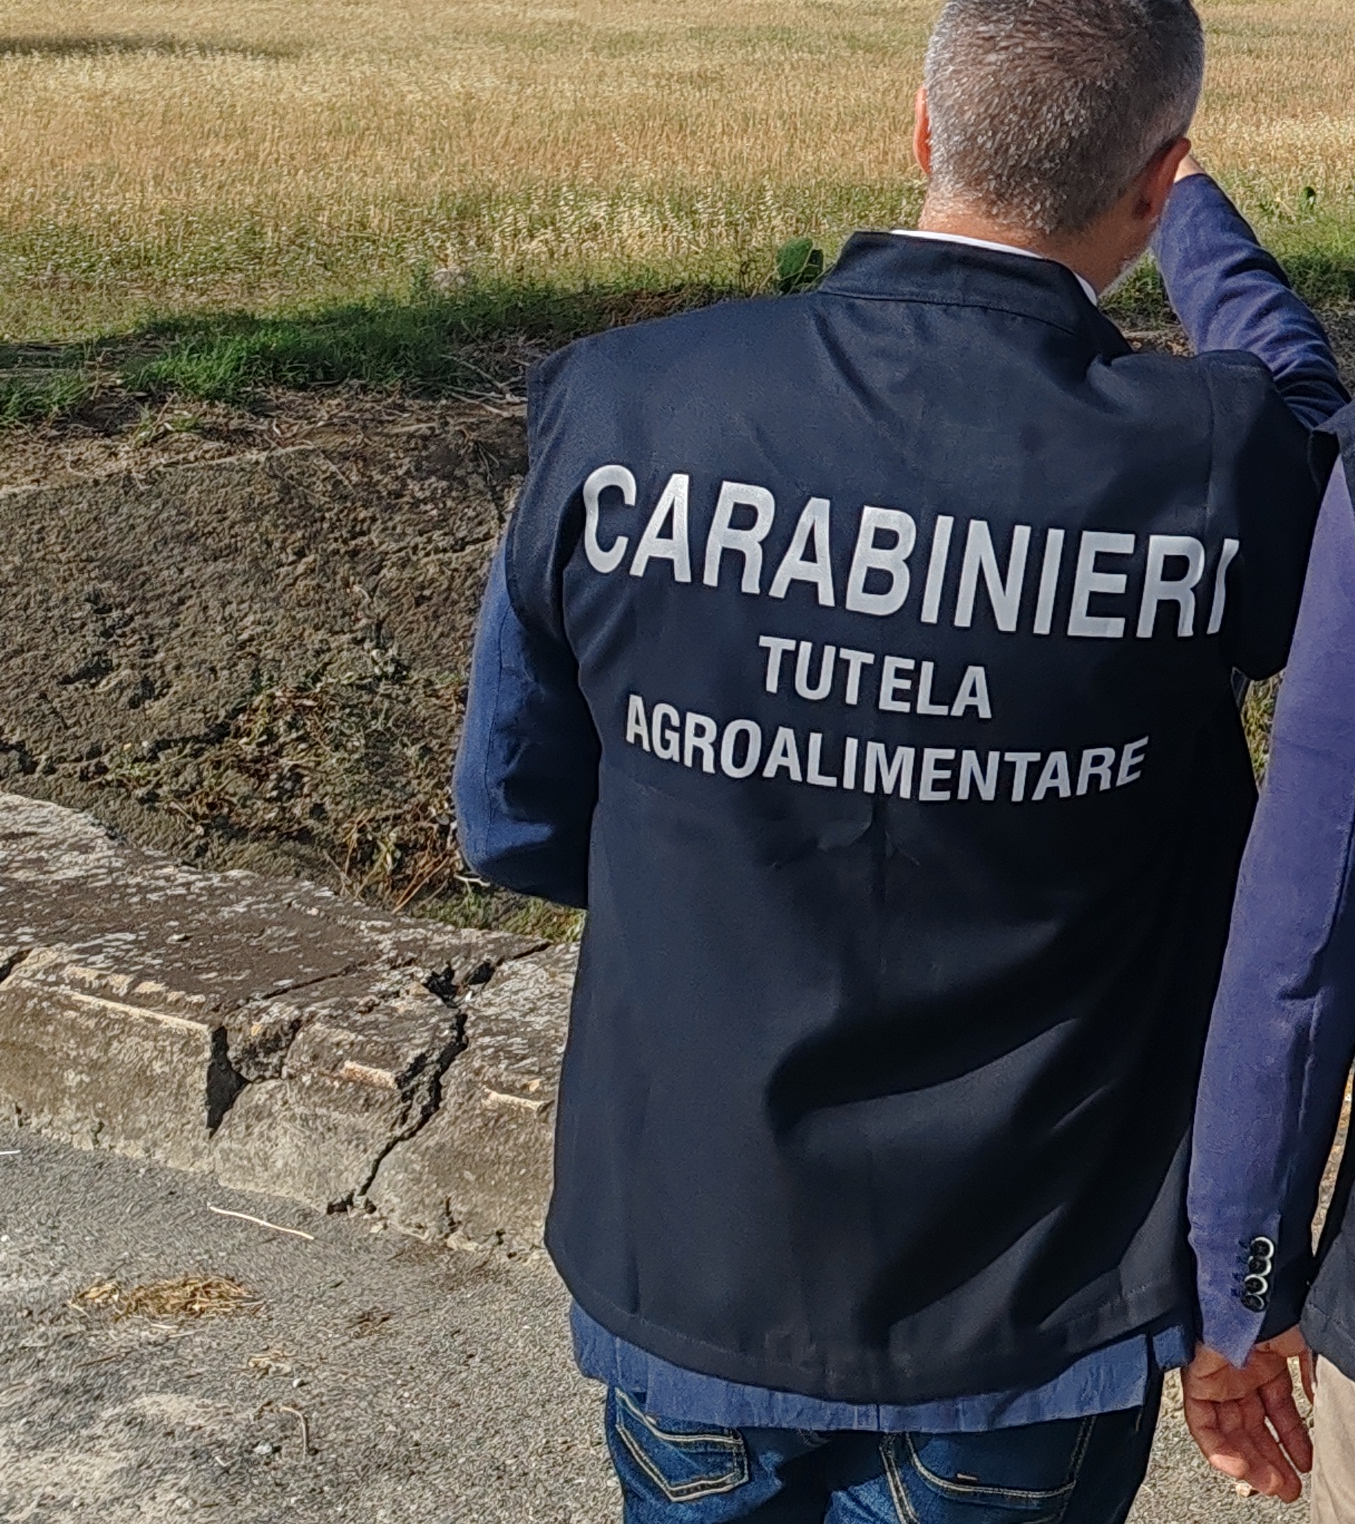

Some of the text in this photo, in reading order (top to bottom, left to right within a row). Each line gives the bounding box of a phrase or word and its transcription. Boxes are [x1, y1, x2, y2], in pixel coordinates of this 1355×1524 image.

[582, 464, 1240, 639] CARABINIERI
[758, 635, 992, 719] TUTELA
[625, 694, 1149, 803] AGROALIMENTARE
